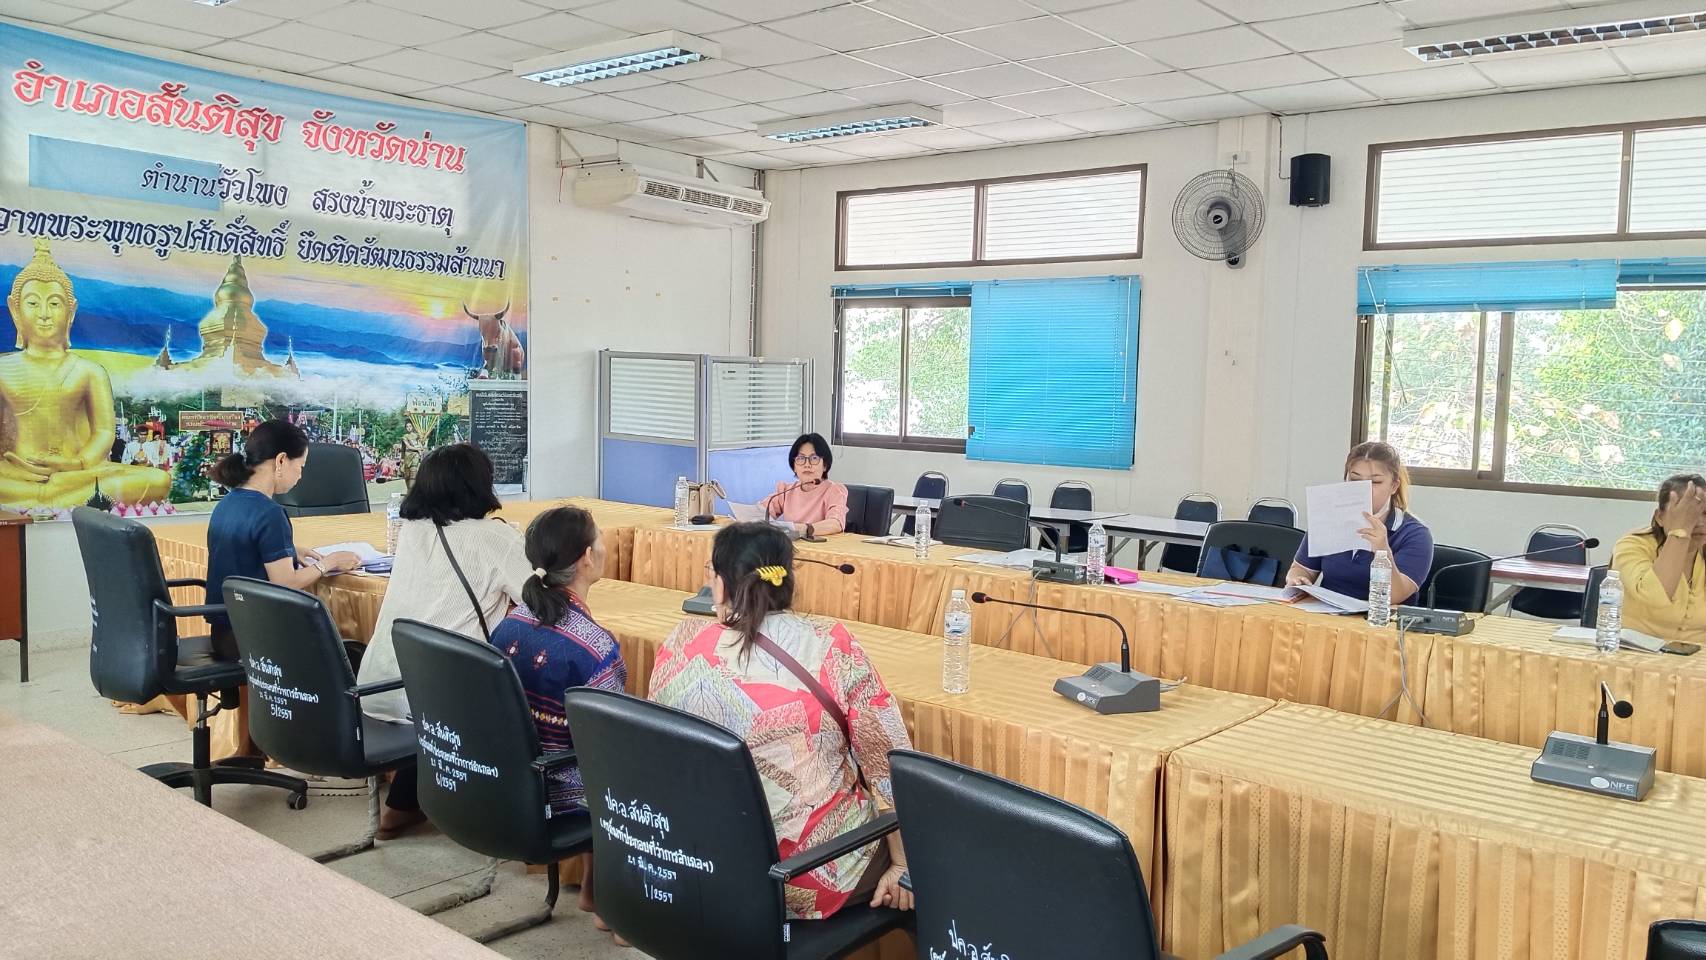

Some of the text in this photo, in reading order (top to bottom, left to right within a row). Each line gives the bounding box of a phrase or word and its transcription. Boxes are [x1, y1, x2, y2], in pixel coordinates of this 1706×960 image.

[13, 60, 466, 172] อำเภอสันติสุข จังหวัดน่าน
[141, 162, 454, 236] ตำนานวัวโพง สรงน้ำพระธาตุ
[297, 230, 505, 278] ยึดติดวัฒนธรรมล้านนา
[1610, 780, 1634, 791] NPE
[604, 787, 671, 840] ปค.อ.สันติสุข
